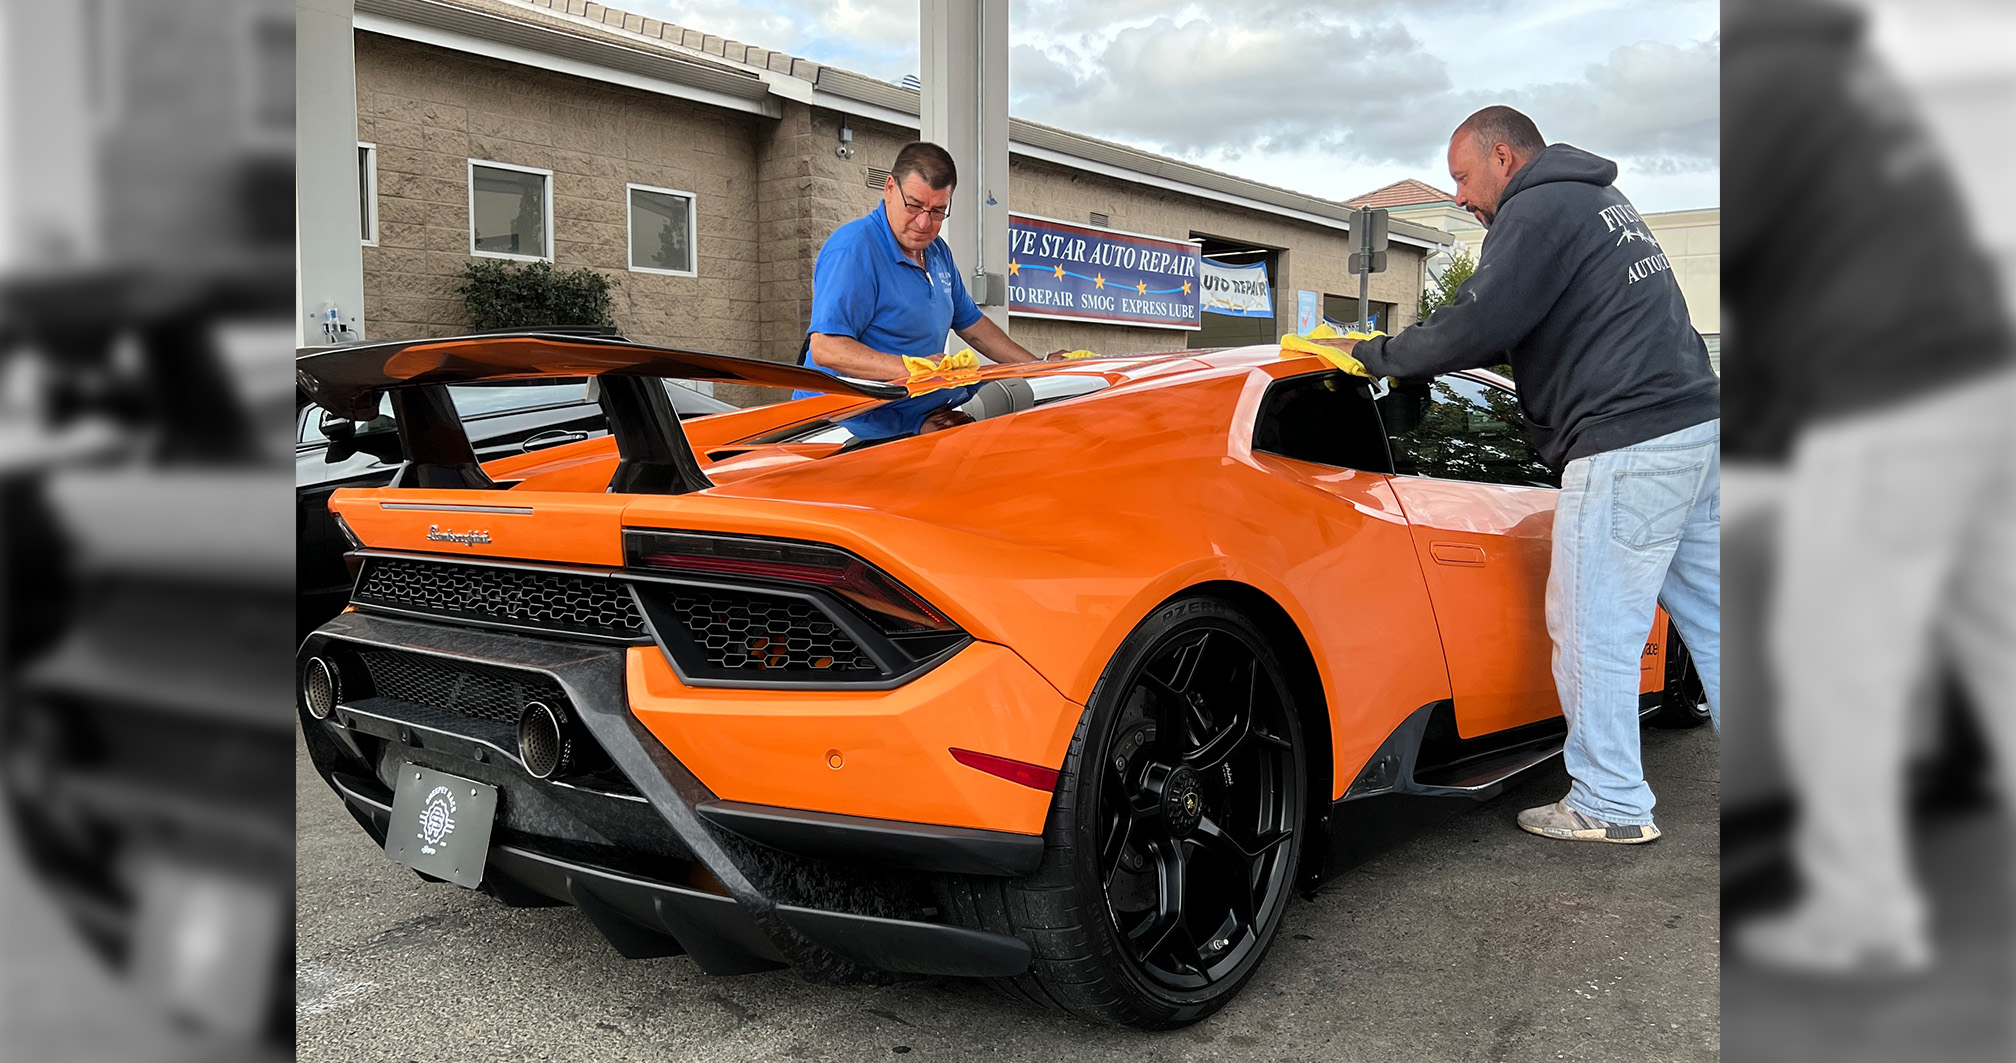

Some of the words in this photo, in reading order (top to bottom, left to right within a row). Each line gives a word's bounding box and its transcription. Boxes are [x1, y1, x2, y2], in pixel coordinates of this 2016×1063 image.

[1039, 233, 1085, 262] STAR
[1088, 242, 1136, 269] AUTO
[1138, 249, 1195, 277] REPAIR
[1028, 287, 1074, 307] REPAIR
[1081, 293, 1115, 311] SMOG
[1122, 298, 1167, 316] EXPRESS
[1169, 303, 1195, 319] LUBE
[1231, 279, 1267, 296] REPAIR
